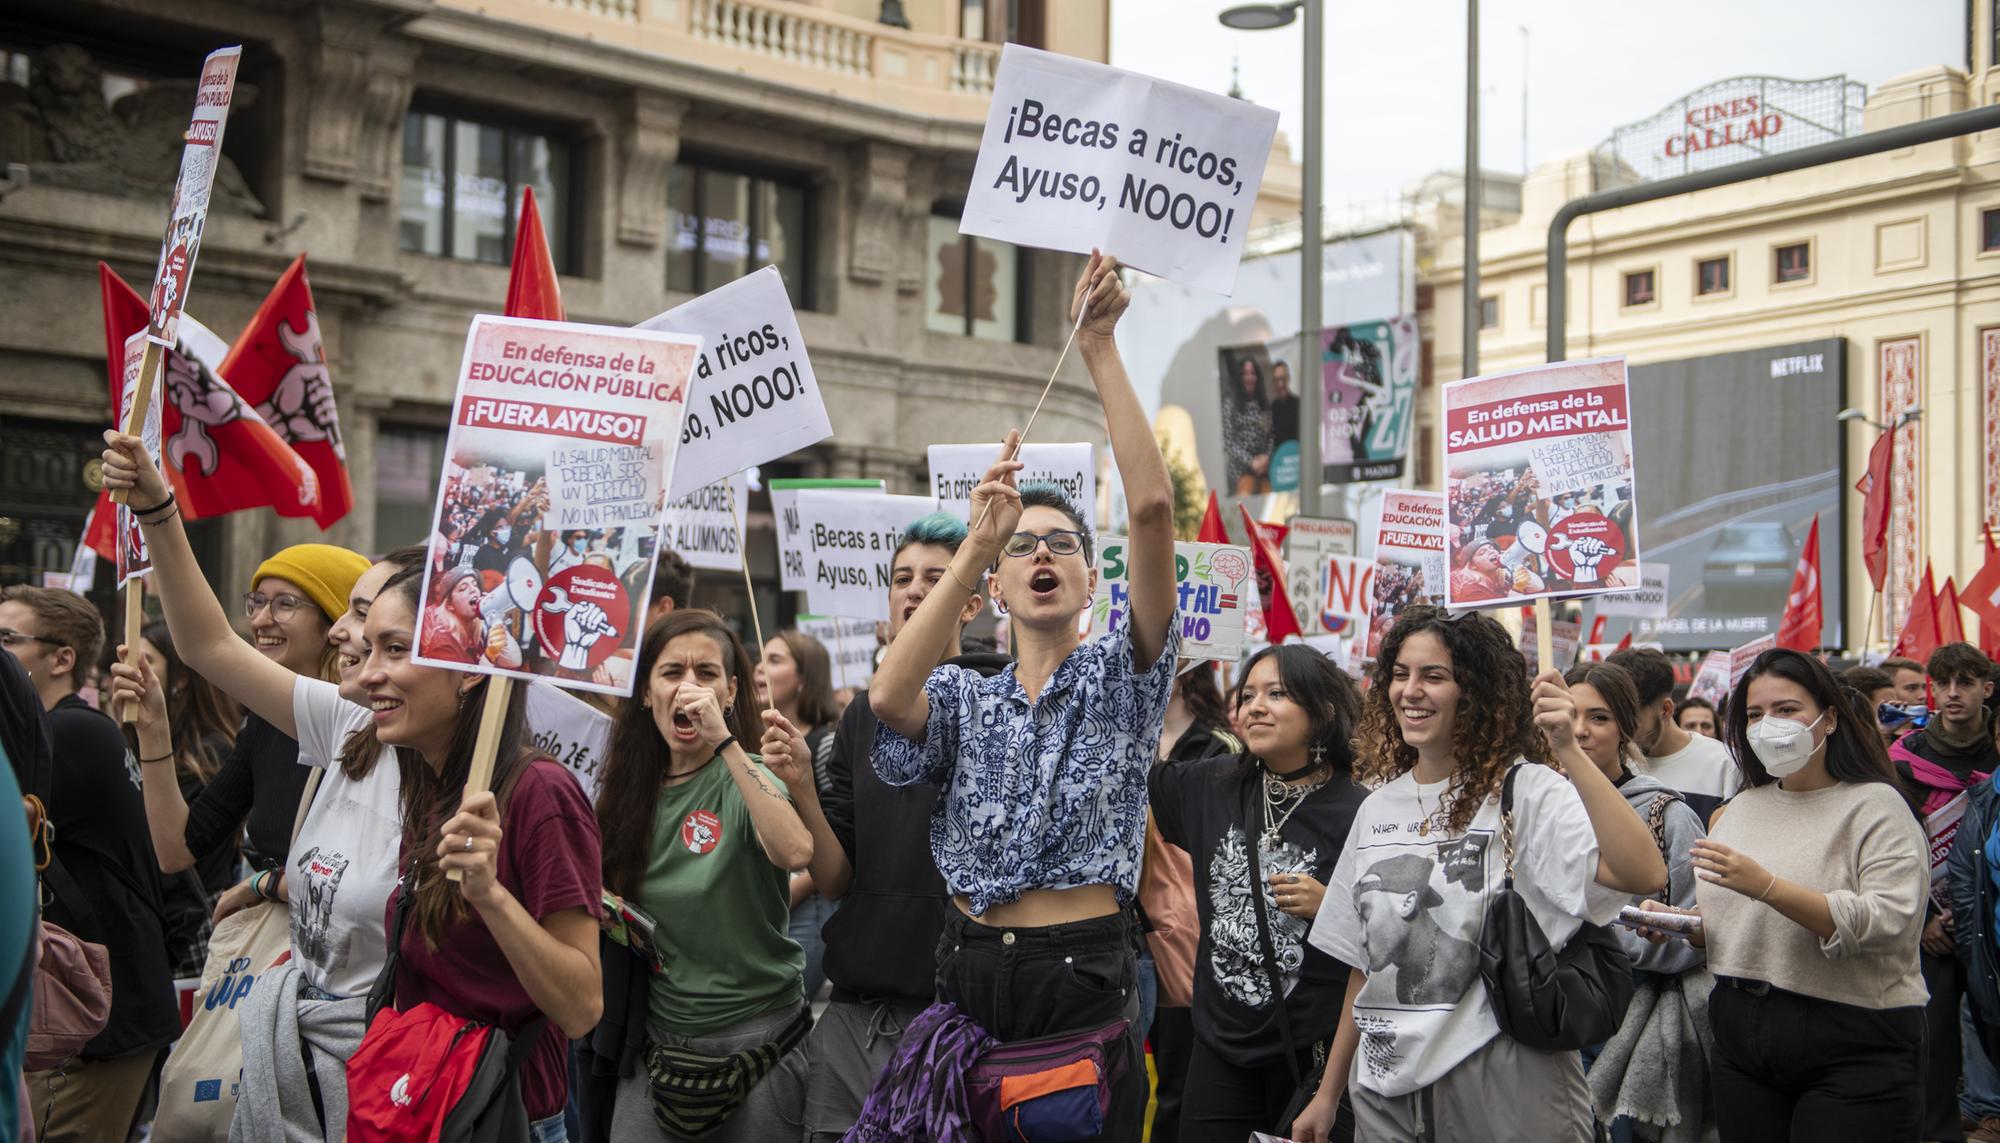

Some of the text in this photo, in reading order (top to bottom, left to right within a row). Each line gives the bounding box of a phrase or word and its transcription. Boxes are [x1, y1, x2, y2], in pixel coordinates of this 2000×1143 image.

[1686, 95, 1759, 128] CINES
[1004, 99, 1242, 196] ¡Becas a ricos,
[1665, 113, 1783, 158] CALLAO
[993, 155, 1234, 243] Ayuso, NOOO!
[502, 341, 656, 375] En defensa de la
[697, 324, 789, 379] a ricos,
[1770, 353, 1824, 379] NETFLIX
[468, 362, 684, 404] EDUCACIÓN PÚBLICA
[710, 361, 805, 428] NOOO!
[466, 399, 641, 440] ¡FUERA AYUSO!
[1468, 392, 1603, 424] En defensa de la
[1449, 408, 1627, 448] SALUD MENTAL
[553, 446, 654, 467] LA SALUD MENTAL
[1545, 439, 1577, 456] SALUD
[617, 461, 645, 479] SER
[562, 477, 647, 502] UN DERECHO
[937, 473, 951, 500] En
[561, 507, 579, 524] NO
[1382, 513, 1440, 528] EDUCACIÓN
[1398, 503, 1410, 512] En
[810, 523, 865, 552] ¡Becas
[871, 532, 880, 550] a
[1383, 532, 1423, 546] ¡FUERA
[817, 560, 872, 590] Ayuso,
[1709, 618, 1724, 632] LA
[1372, 823, 1399, 834] WHEN
